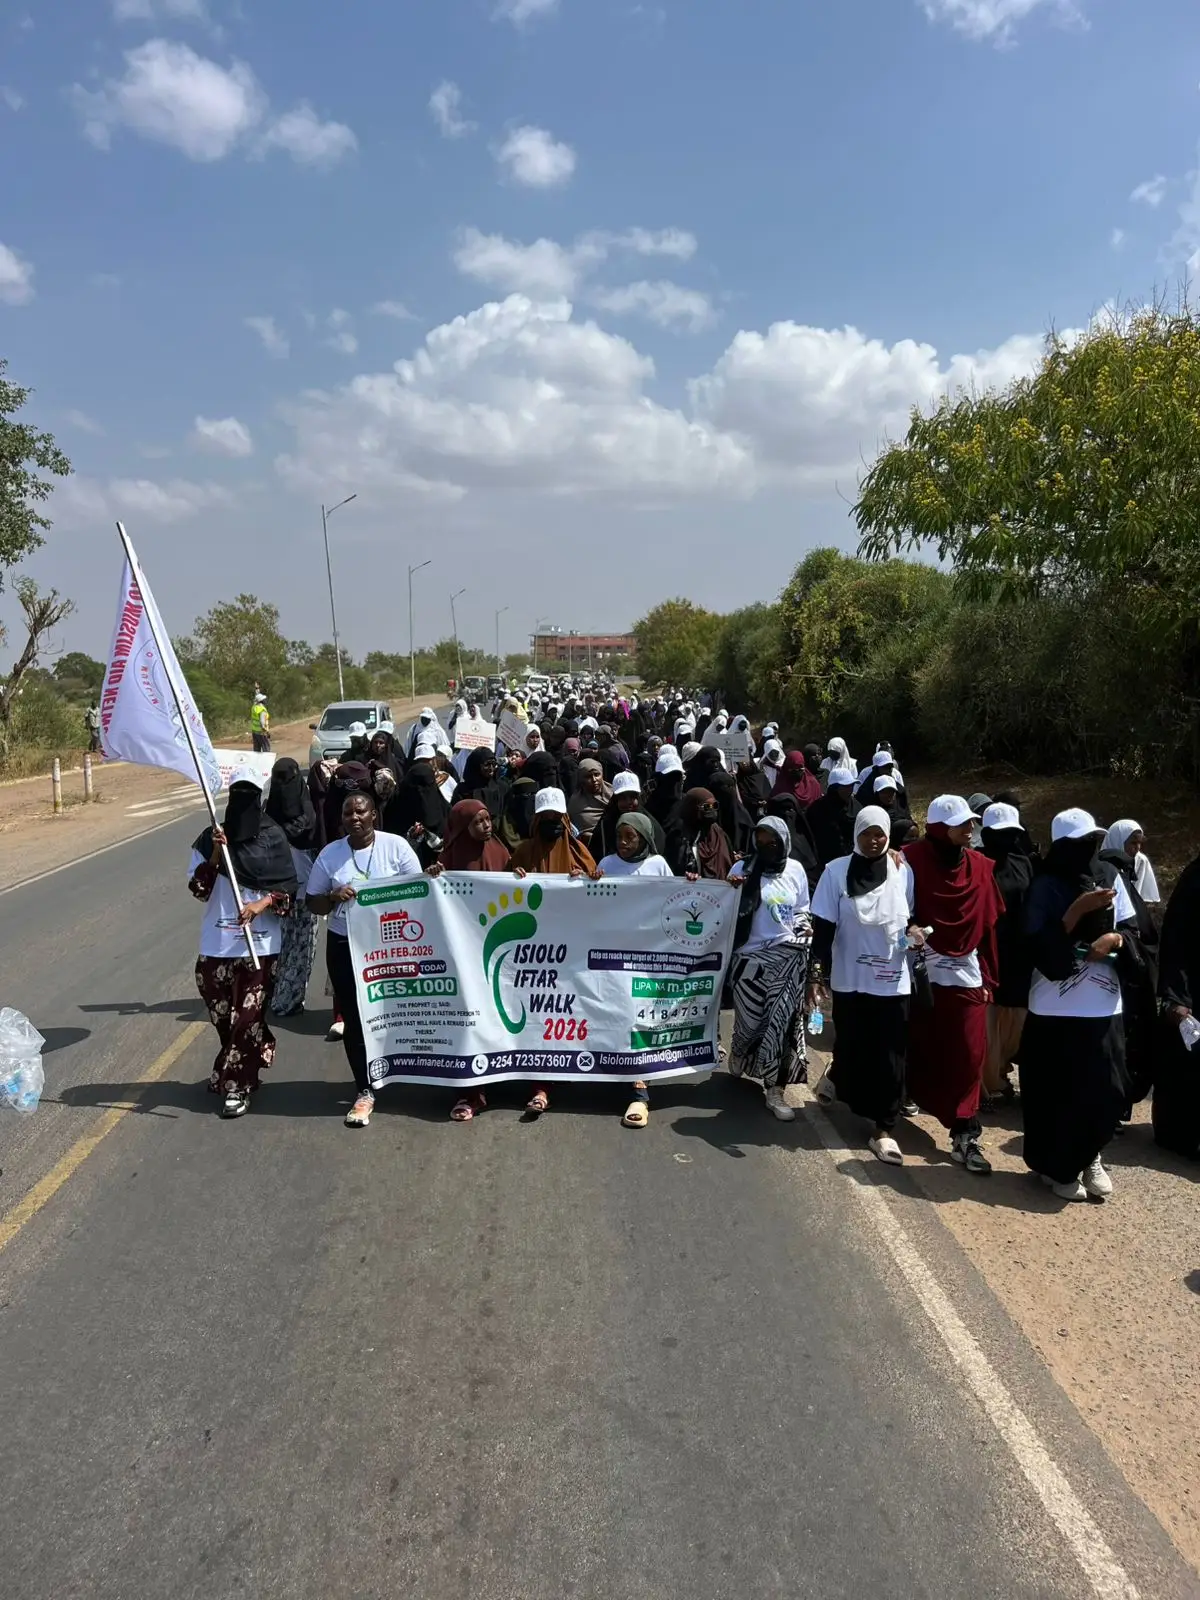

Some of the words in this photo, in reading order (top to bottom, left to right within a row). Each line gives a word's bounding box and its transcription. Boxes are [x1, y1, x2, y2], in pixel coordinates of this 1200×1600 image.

[363, 948, 388, 962] 14TH
[390, 945, 434, 959] FEB.2026
[513, 943, 567, 964] ISIOLO
[590, 950, 602, 960] Help
[608, 952, 623, 960] reach
[366, 964, 416, 978] REGISTER
[419, 962, 446, 973] TODAY
[513, 969, 558, 989] IFTAR
[634, 981, 652, 991] LIPA
[655, 983, 666, 991] NA
[369, 978, 455, 1000] KES.1000
[529, 993, 576, 1015] WALK
[543, 1017, 588, 1041] 2026
[651, 1029, 692, 1045] IFTAR
[489, 1054, 513, 1069] +254
[514, 1053, 572, 1068] 723573607
